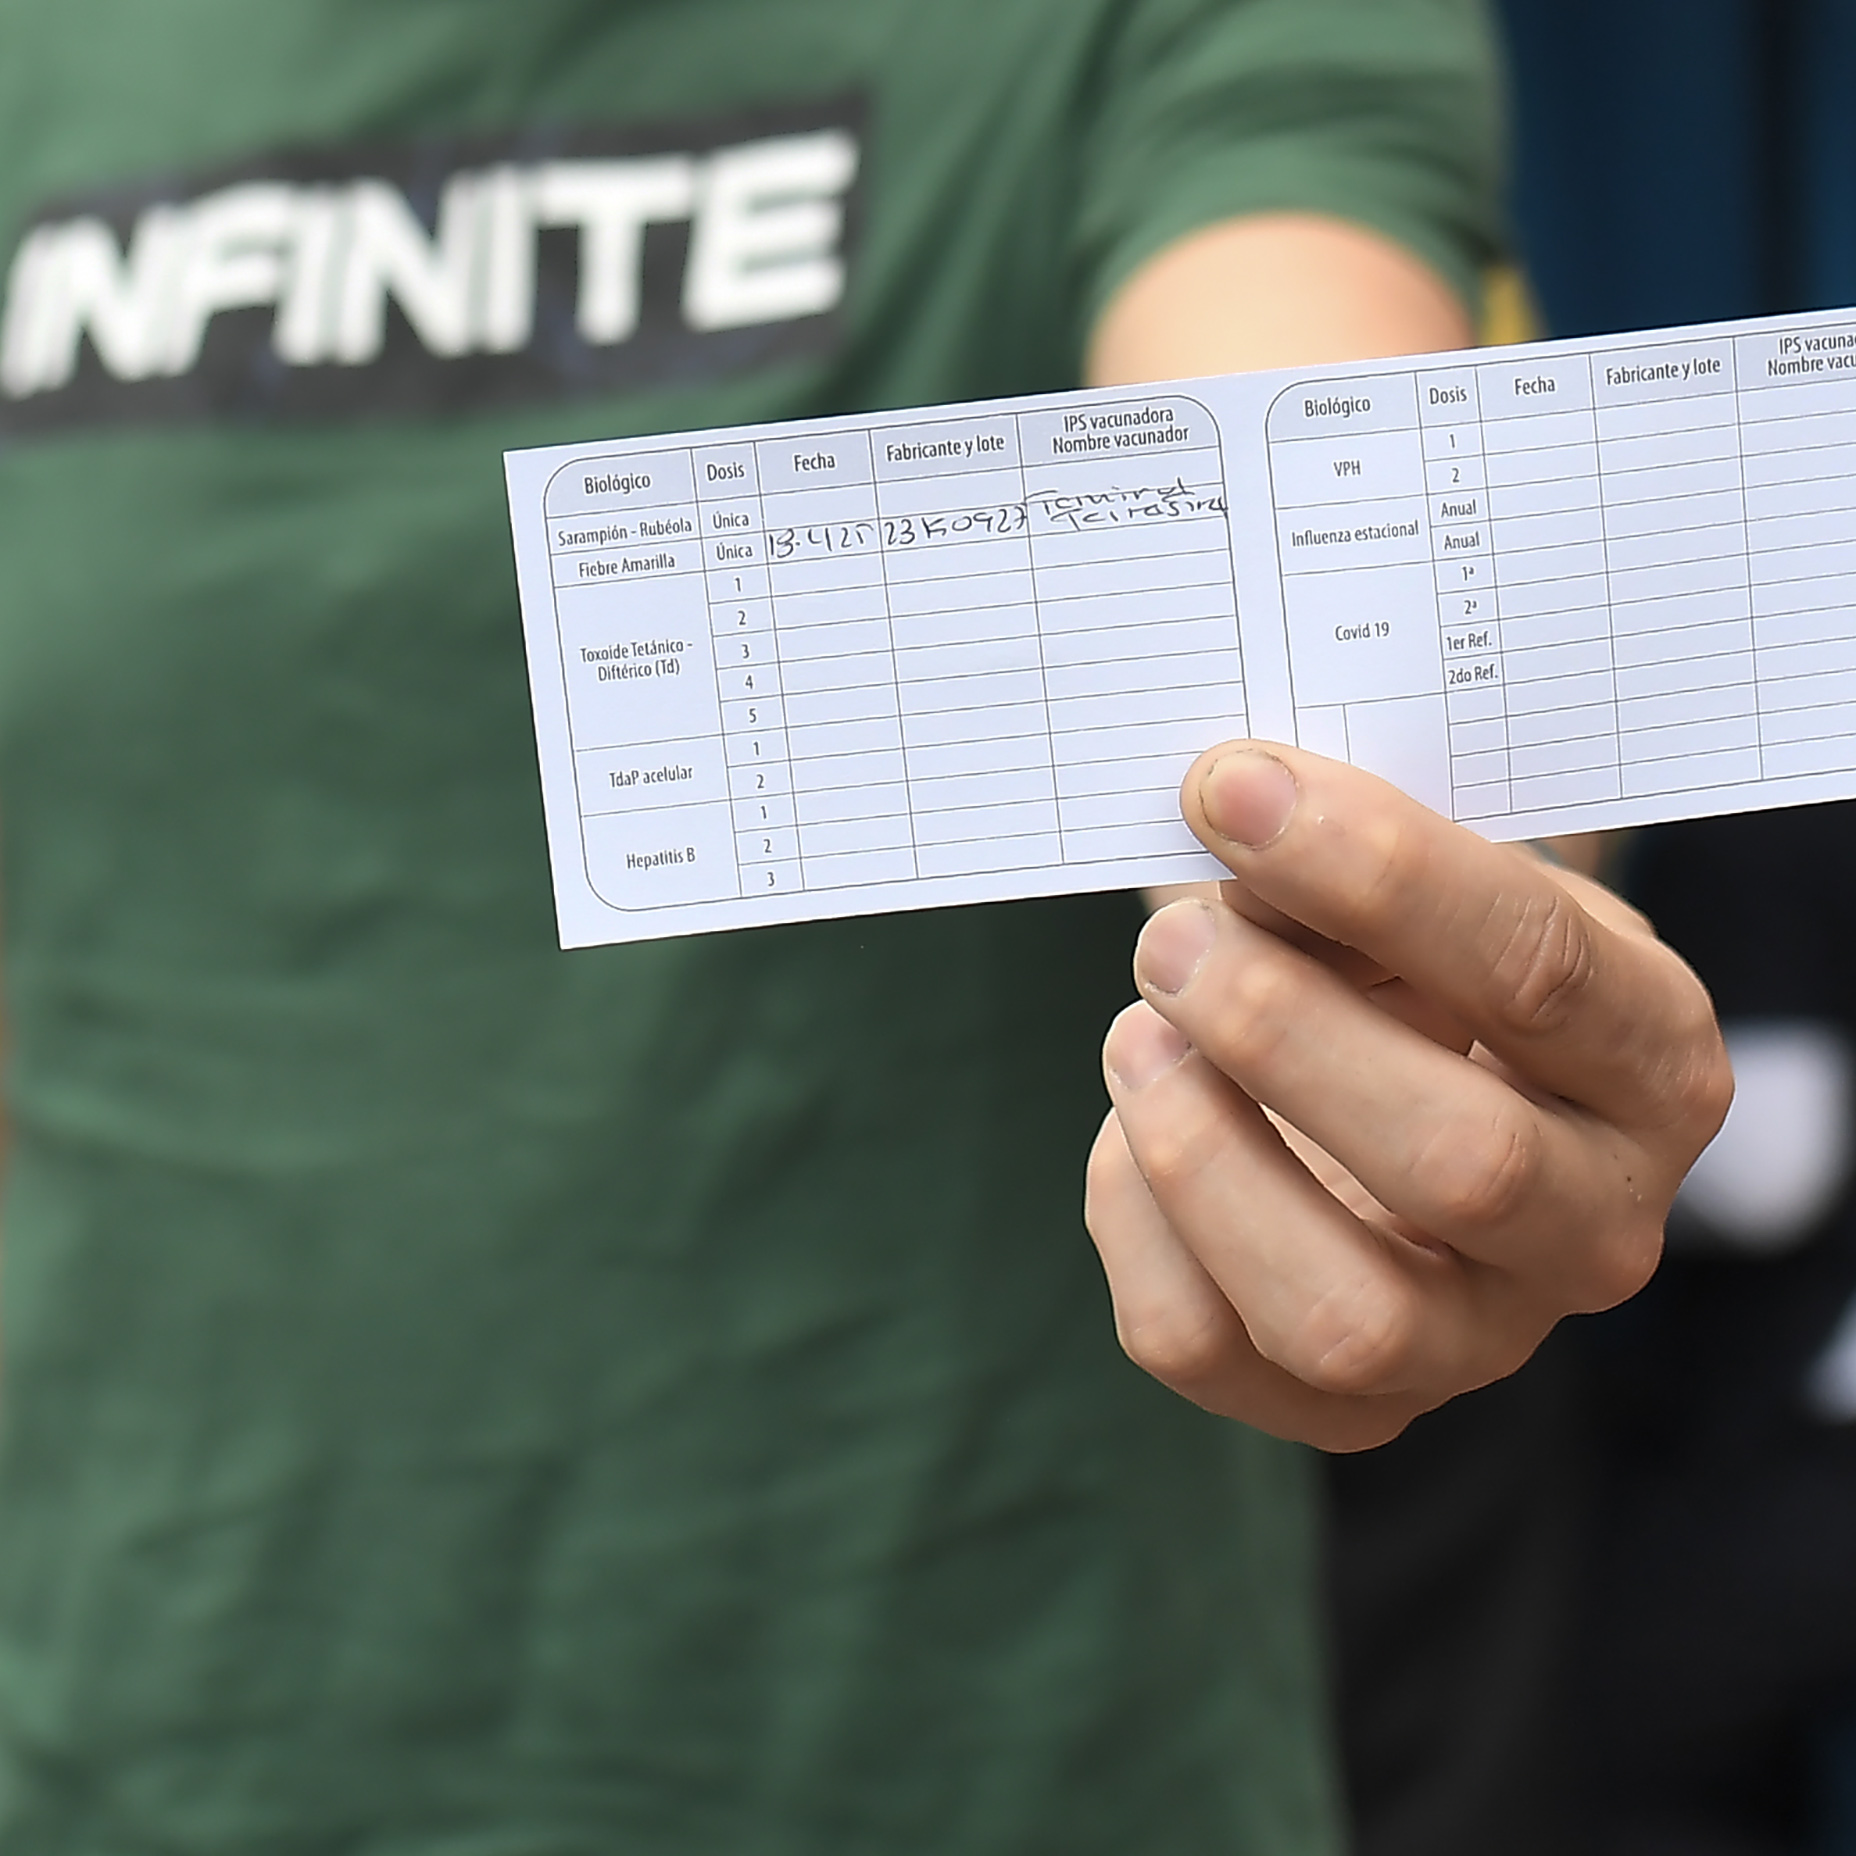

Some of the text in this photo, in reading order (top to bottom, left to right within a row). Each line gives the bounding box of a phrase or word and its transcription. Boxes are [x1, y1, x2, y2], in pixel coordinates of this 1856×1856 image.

[1779, 336, 1802, 355] IPS
[1606, 358, 1721, 386] Fabricante y lote
[1767, 358, 1824, 376] Nombre
[1514, 376, 1555, 395] Fecha
[1429, 386, 1468, 405] Dosis
[1304, 397, 1371, 418] Biológico
[1064, 407, 1174, 433] IPS vacunadora
[887, 435, 1005, 462] Fabricante y lote
[1052, 425, 1190, 454] Nombre vacunador
[1449, 434, 1456, 448] 1
[707, 462, 745, 481] Dosis
[794, 452, 836, 472] Fecha
[1333, 460, 1361, 477] VPH
[584, 472, 651, 495] Biológico
[1451, 468, 1460, 483] 2
[1441, 499, 1477, 518] Anual
[713, 511, 750, 529] Única
[558, 525, 628, 546] Sarampión
[640, 517, 692, 537] Rubéola
[1292, 519, 1419, 547] Influenza estacional
[1444, 531, 1480, 550] Anual
[716, 543, 753, 561] Única
[579, 553, 675, 578] Fiebre Amarilla
[735, 577, 742, 592] 1
[737, 610, 746, 625] 2
[1335, 621, 1390, 641] Covid 19
[1446, 631, 1492, 651] 1er Ref.
[580, 644, 629, 663] Toxoide
[631, 640, 684, 657] Tetánico
[742, 644, 750, 659] 3
[598, 658, 680, 681] Diftérico (Td)
[1448, 664, 1498, 685] 2do Ref.
[745, 675, 753, 689] 4
[749, 708, 757, 723] 5
[753, 741, 760, 756] 1
[609, 765, 693, 788] TdaP acelular
[756, 774, 765, 789] 2
[761, 805, 767, 819] 1
[763, 839, 772, 853] 2
[626, 847, 696, 871] Hepatitis B
[767, 872, 775, 887] 3
